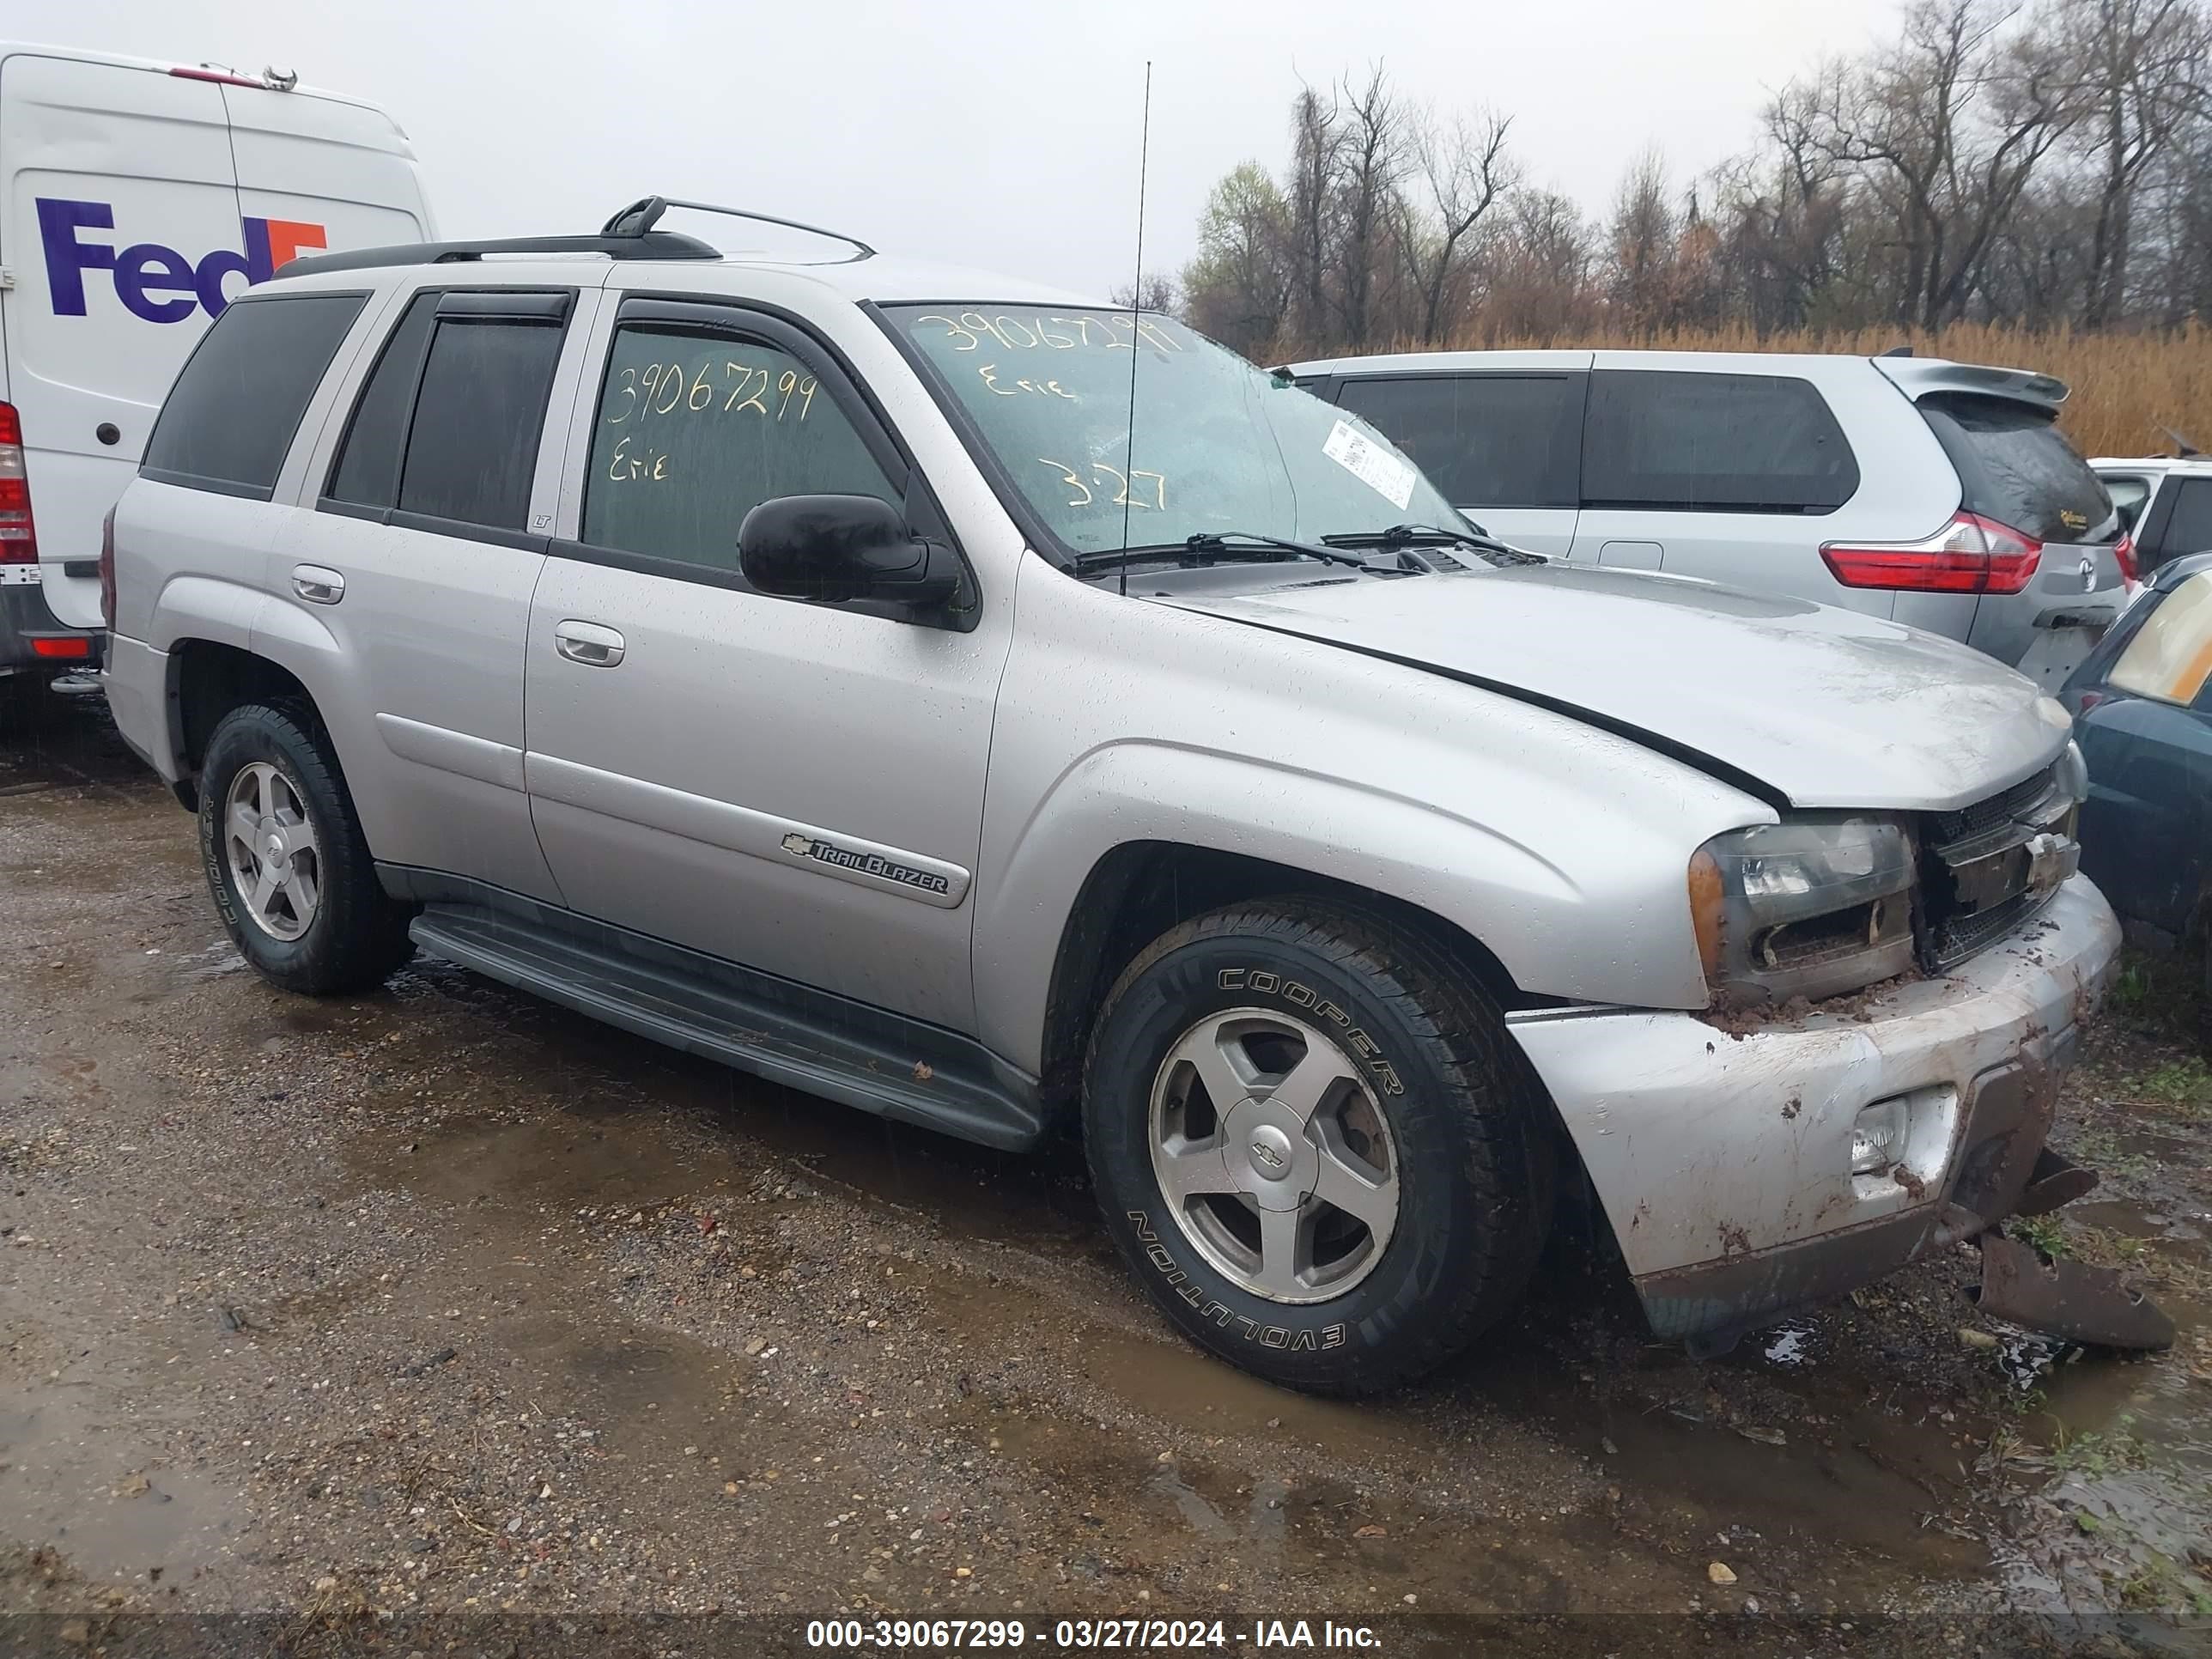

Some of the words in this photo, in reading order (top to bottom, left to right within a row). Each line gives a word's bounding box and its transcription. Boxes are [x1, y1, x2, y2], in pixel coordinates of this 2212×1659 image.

[608, 362, 818, 423] 39067299
[533, 515, 551, 528] LT
[1217, 967, 1407, 1097] COOPER
[1127, 1210, 1346, 1352] EVOLUTION
